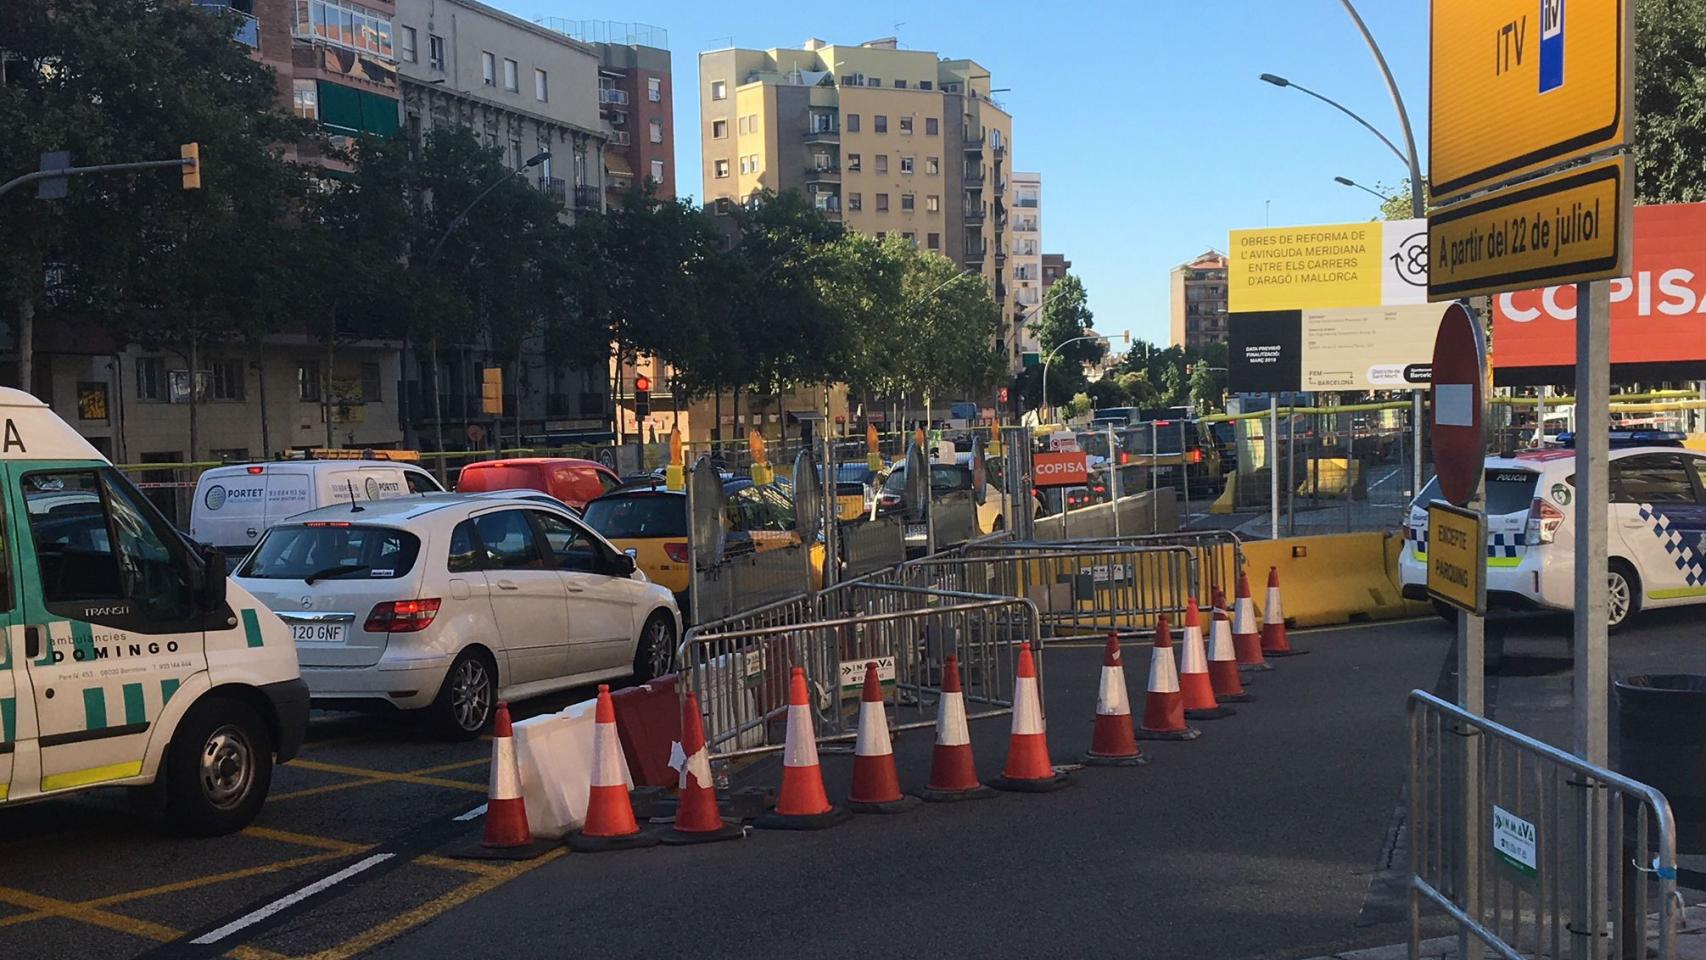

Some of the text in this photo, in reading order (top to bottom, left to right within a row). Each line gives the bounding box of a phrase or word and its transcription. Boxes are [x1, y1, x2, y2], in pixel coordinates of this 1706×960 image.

[1497, 15, 1526, 76] ITV
[1241, 230, 1366, 247] OBRES DE REFORMA DE
[1439, 197, 1599, 274] A partir del 22 de juliol
[1305, 244, 1366, 256] MERIDIANA
[1248, 257, 1358, 273] ENTRE ELS CARRERS
[1248, 273, 1292, 286] D'ARAGÓ
[1301, 271, 1358, 283] MALLORCA
[1499, 268, 1706, 323] COPIS
[1036, 461, 1085, 474] COPISA
[1496, 473, 1528, 482] POLICIA
[228, 488, 263, 498] PORTET
[85, 606, 129, 617] TRANSIT
[317, 625, 342, 640] GNF
[52, 641, 179, 663] DOMINGO
[852, 658, 893, 671] INVA
